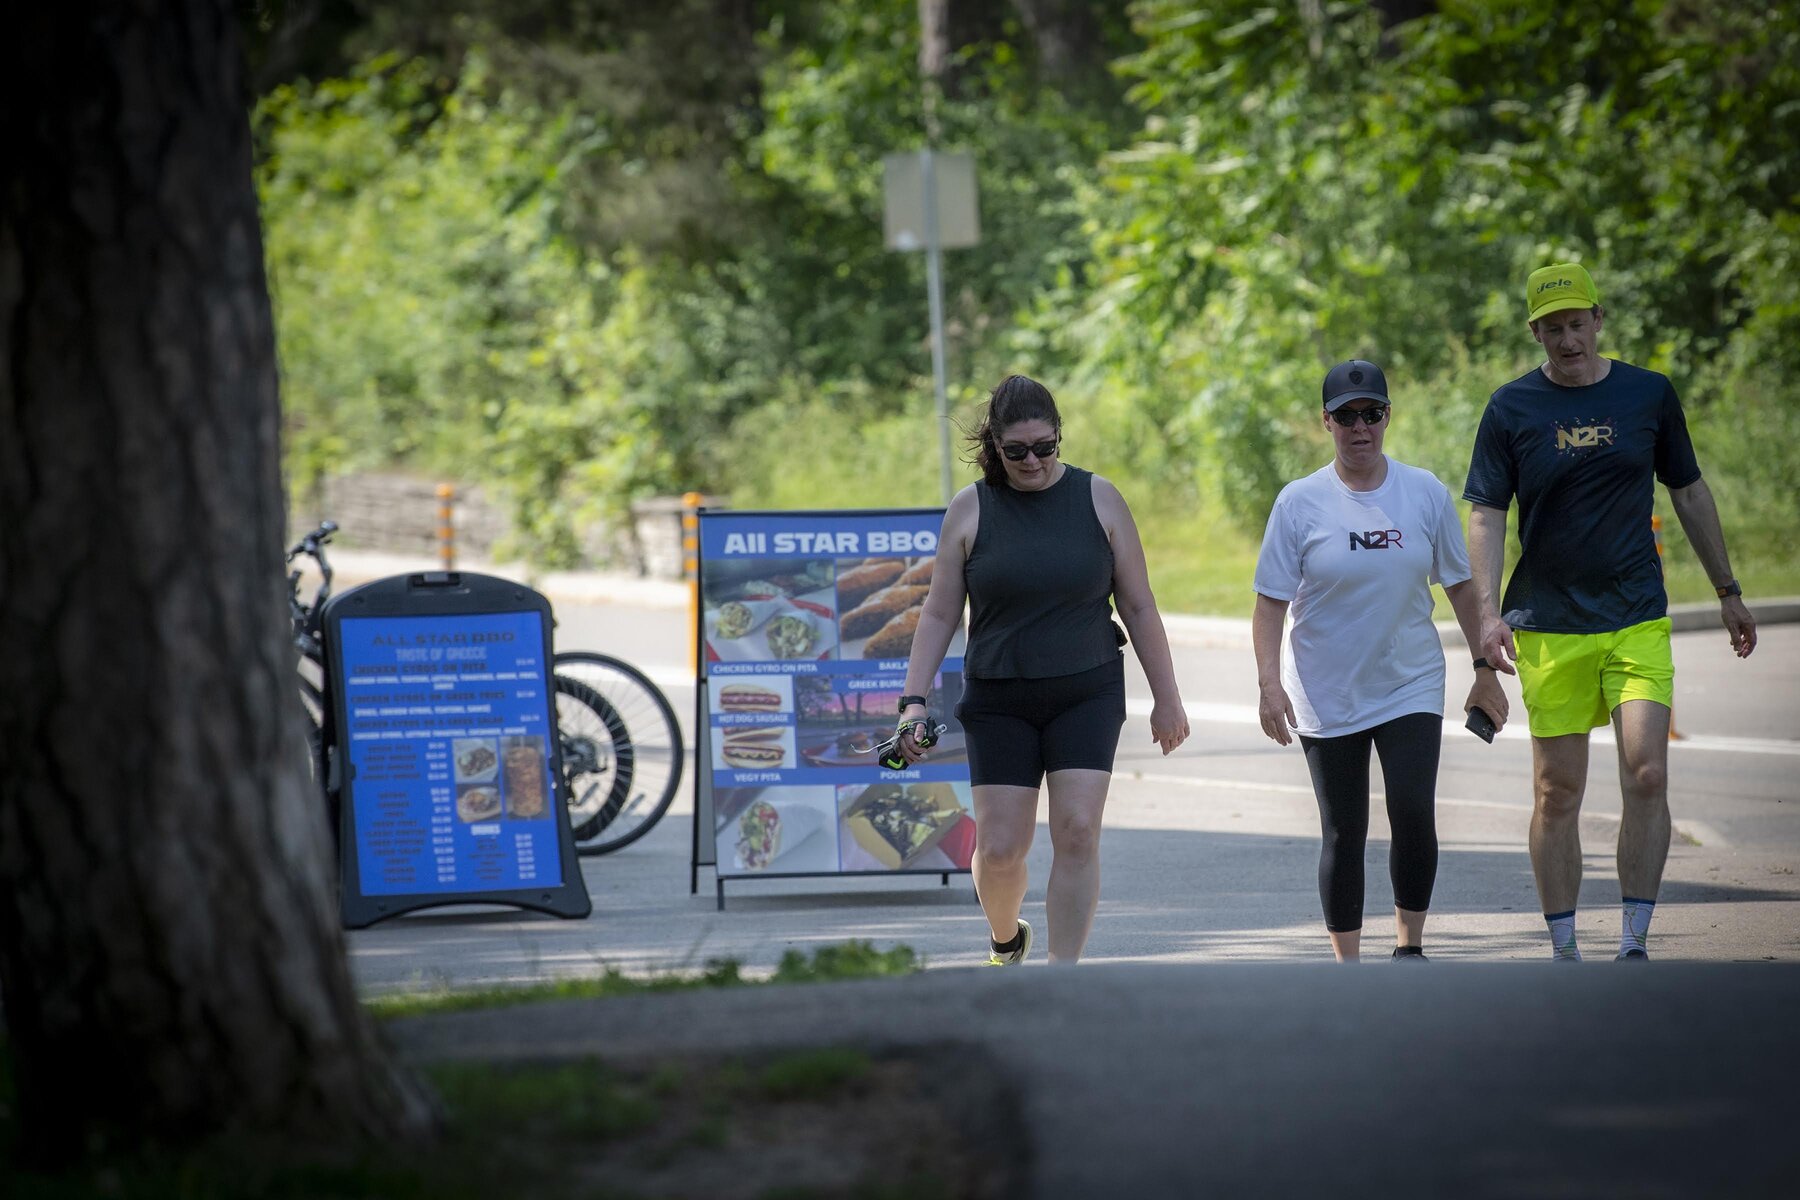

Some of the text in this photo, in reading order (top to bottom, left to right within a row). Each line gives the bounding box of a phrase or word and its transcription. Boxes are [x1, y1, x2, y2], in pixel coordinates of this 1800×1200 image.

[1556, 425, 1614, 449] N2R
[773, 531, 860, 553] STAR
[867, 530, 937, 553] BBQ
[1349, 529, 1403, 551] N2R
[416, 633, 466, 644] STAR
[430, 648, 443, 661] OF
[713, 663, 818, 674] CHICKEN GYRO ON PITA
[879, 661, 909, 670] BAKLA
[848, 679, 906, 689] GREEK BURG
[718, 713, 788, 723] HOT DOG SAUSAGE
[734, 772, 781, 782] VEGY PITA
[880, 770, 920, 779] POUTINE
